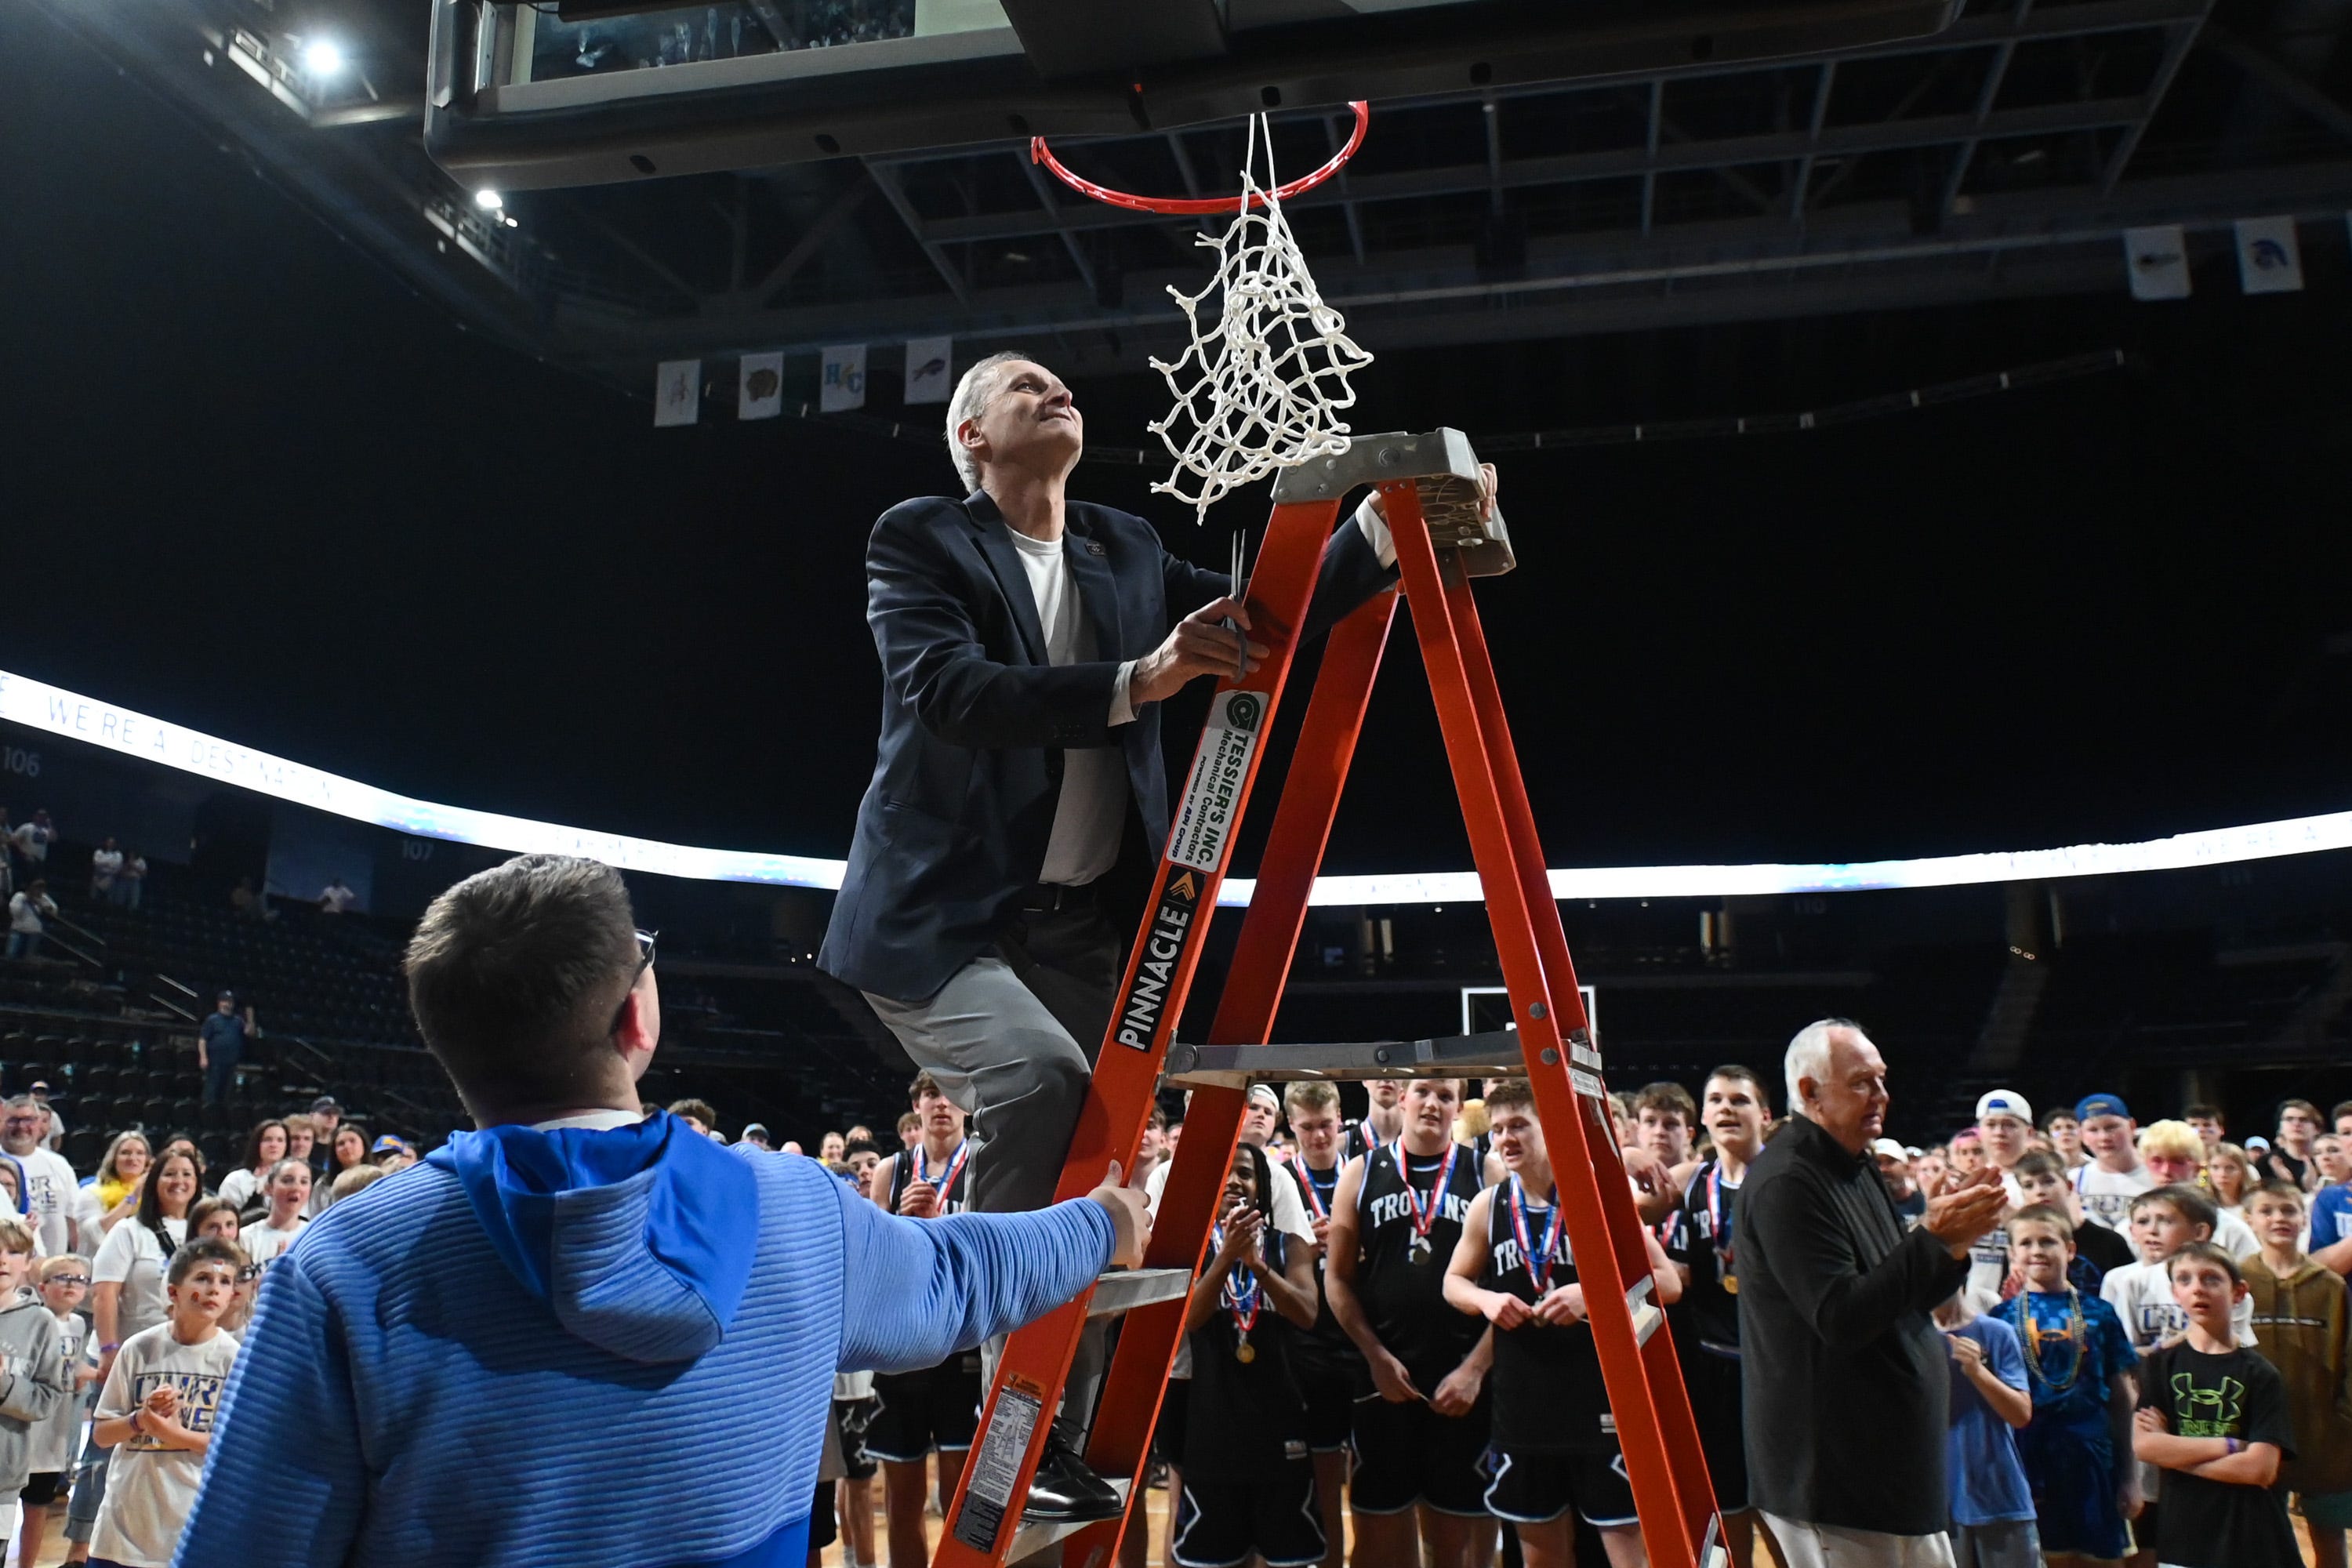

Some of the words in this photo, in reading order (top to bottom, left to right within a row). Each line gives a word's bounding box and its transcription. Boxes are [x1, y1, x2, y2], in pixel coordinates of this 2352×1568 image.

[4, 746, 40, 778] 106
[153, 728, 166, 754] A
[191, 739, 333, 803] DESTNATN
[1192, 755, 1207, 793] POWERED
[1206, 729, 1233, 794] Mechanical
[1210, 734, 1249, 825] TESSIER'S
[1188, 793, 1196, 806] BY
[1185, 797, 1213, 862] Contractors
[1196, 826, 1220, 866] INC.
[402, 840, 435, 860] 107
[1119, 906, 1189, 1051] PINNACLE
[1370, 1189, 1472, 1229] TROJNS
